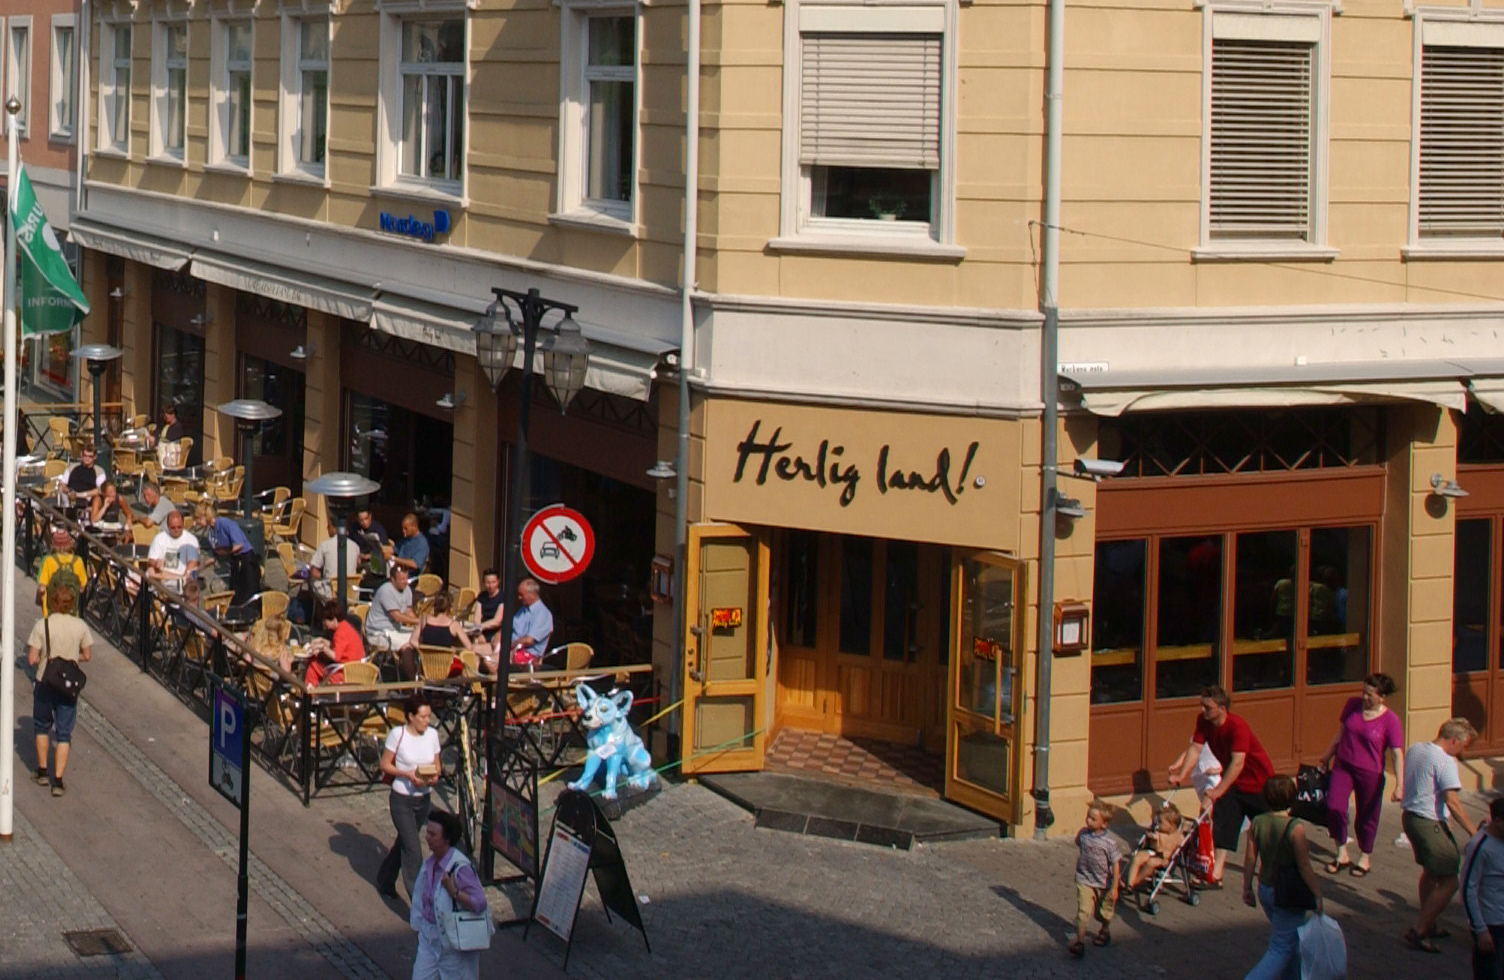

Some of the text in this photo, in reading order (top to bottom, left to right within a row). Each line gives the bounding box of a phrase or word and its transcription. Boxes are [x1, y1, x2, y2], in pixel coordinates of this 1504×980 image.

[379, 212, 433, 239] Nordea
[733, 419, 980, 507] Herlig land!
[220, 699, 236, 749] P
